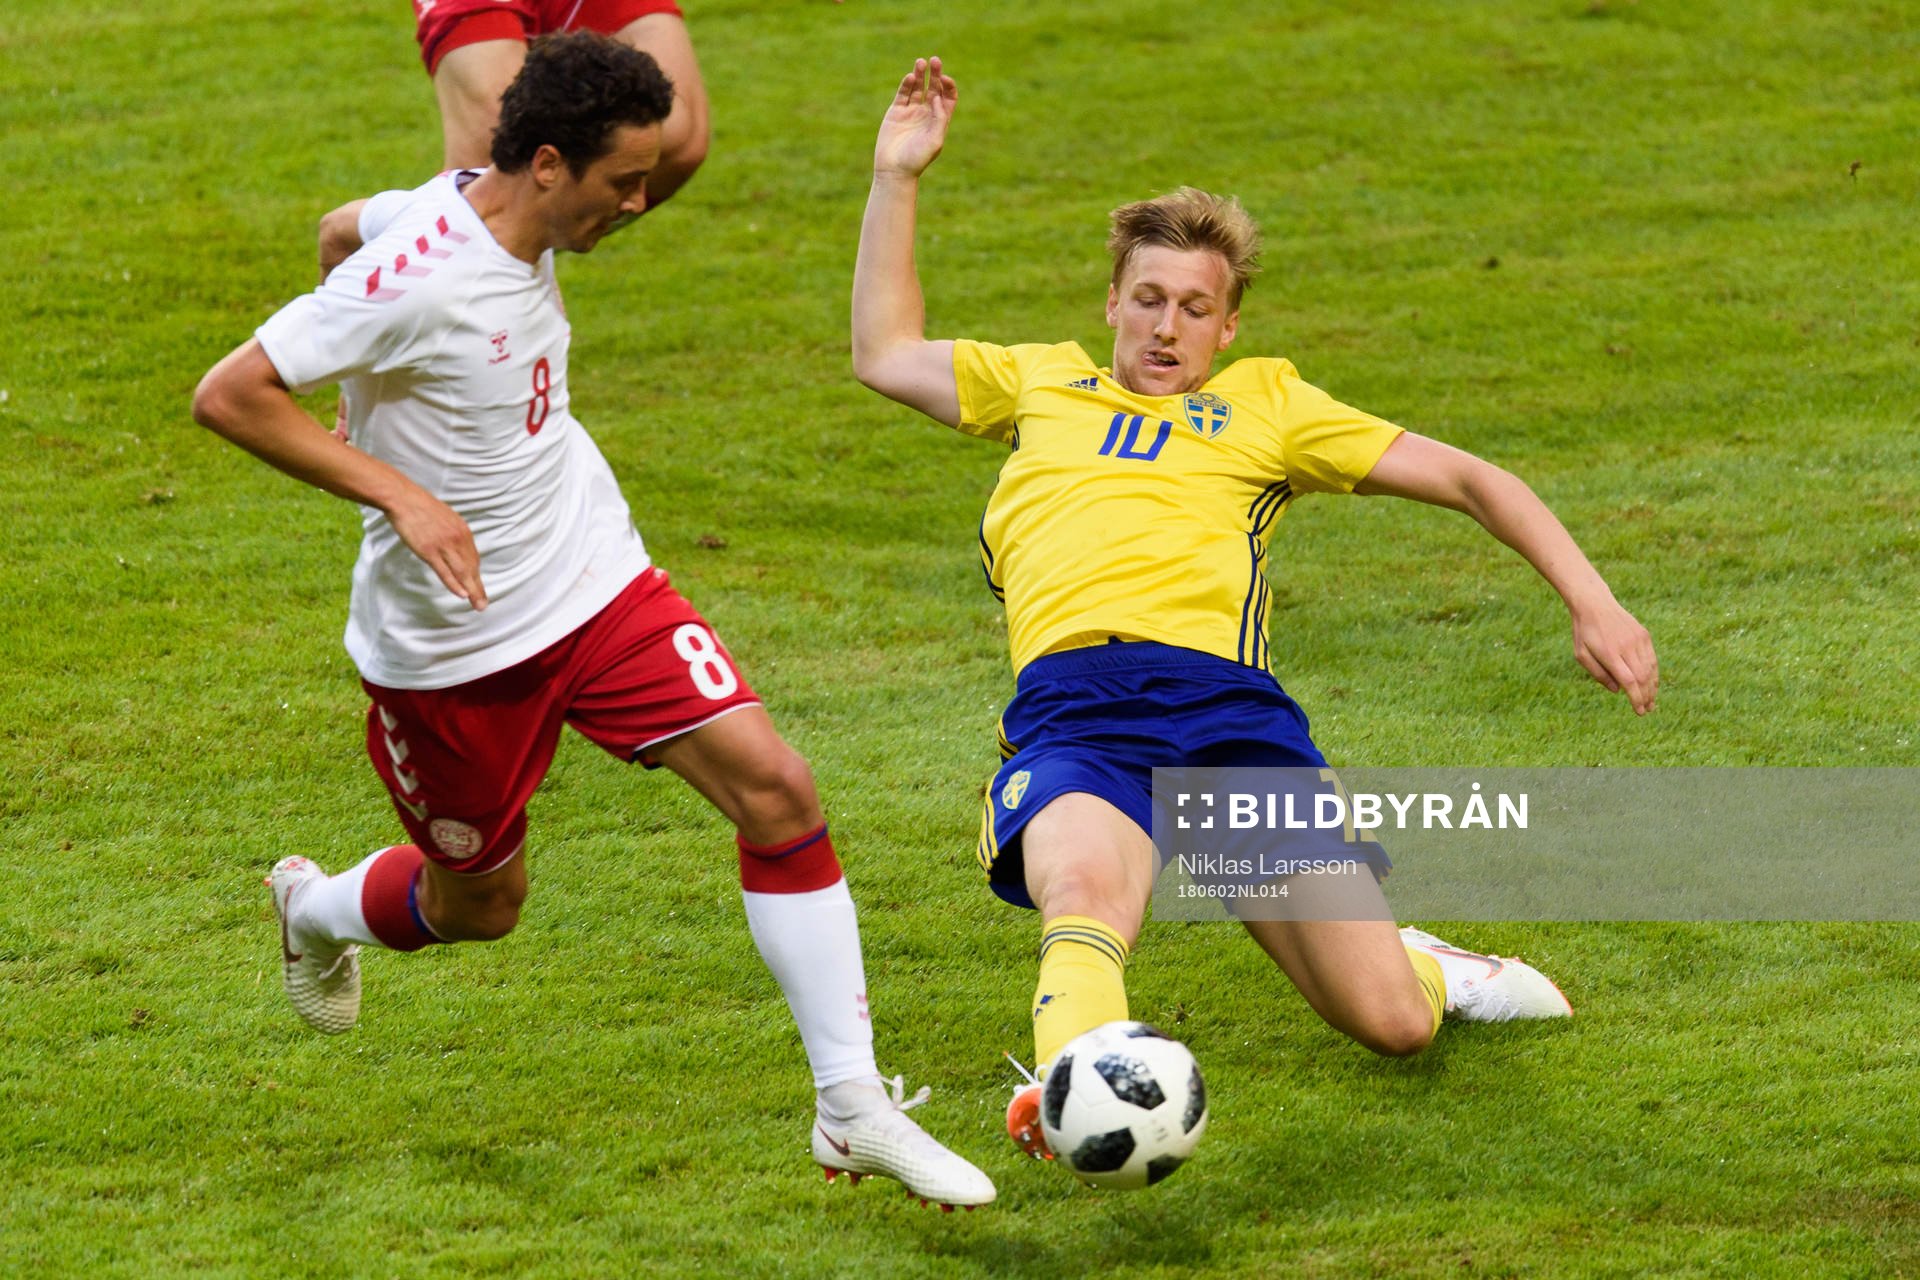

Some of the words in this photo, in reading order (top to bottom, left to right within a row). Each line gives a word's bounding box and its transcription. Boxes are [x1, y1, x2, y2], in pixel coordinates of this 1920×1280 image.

[526, 357, 550, 436] 8
[1098, 411, 1173, 461] 10
[672, 623, 738, 700] 8
